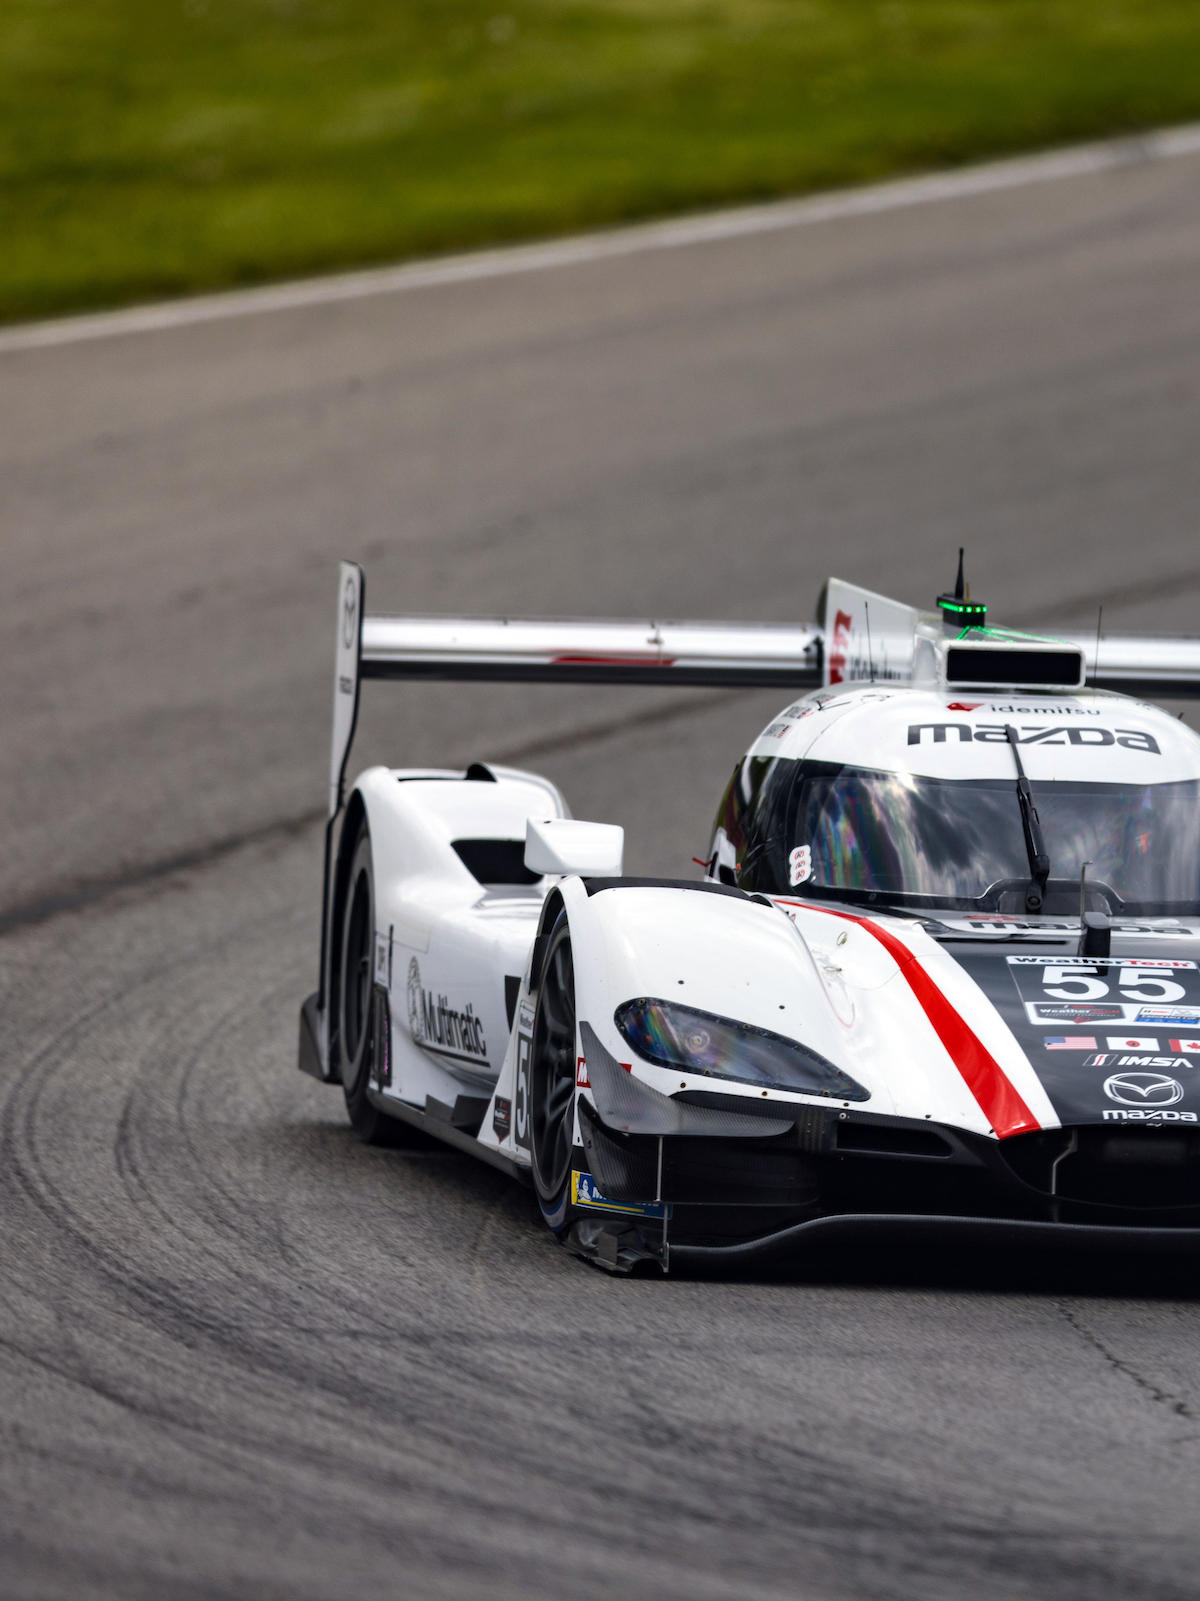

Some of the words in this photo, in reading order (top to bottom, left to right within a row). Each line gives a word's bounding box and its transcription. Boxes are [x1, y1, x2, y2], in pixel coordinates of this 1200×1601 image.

[990, 704, 1101, 715] idemitsu
[1014, 957, 1188, 967] WeatherTech
[1042, 966, 1187, 1003] 55
[422, 988, 487, 1057] Multimatic
[1117, 1056, 1194, 1068] IMSA
